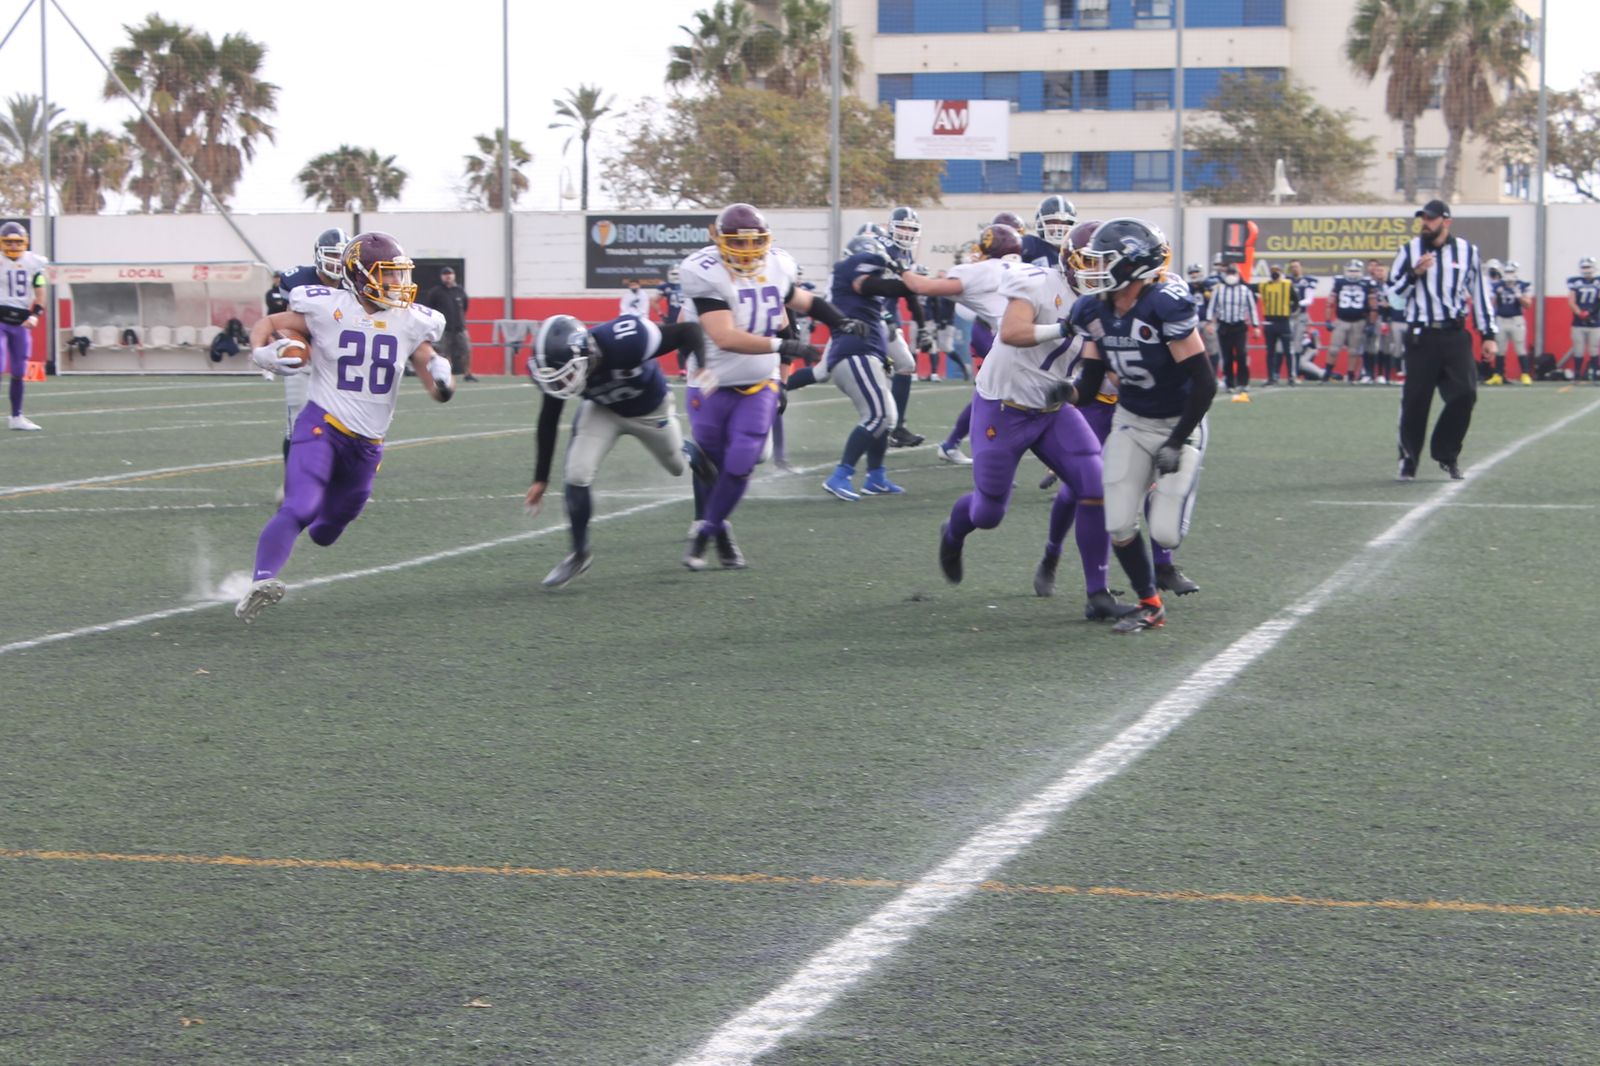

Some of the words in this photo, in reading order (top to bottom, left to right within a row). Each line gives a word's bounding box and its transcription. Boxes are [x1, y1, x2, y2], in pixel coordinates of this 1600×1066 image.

[1292, 218, 1405, 234] MUDANZAS
[8, 270, 27, 297] 19
[118, 268, 165, 279] LOCAL
[1578, 287, 1597, 304] 77
[737, 285, 782, 337] 72
[336, 329, 399, 395] 28
[1105, 350, 1156, 390] 15
